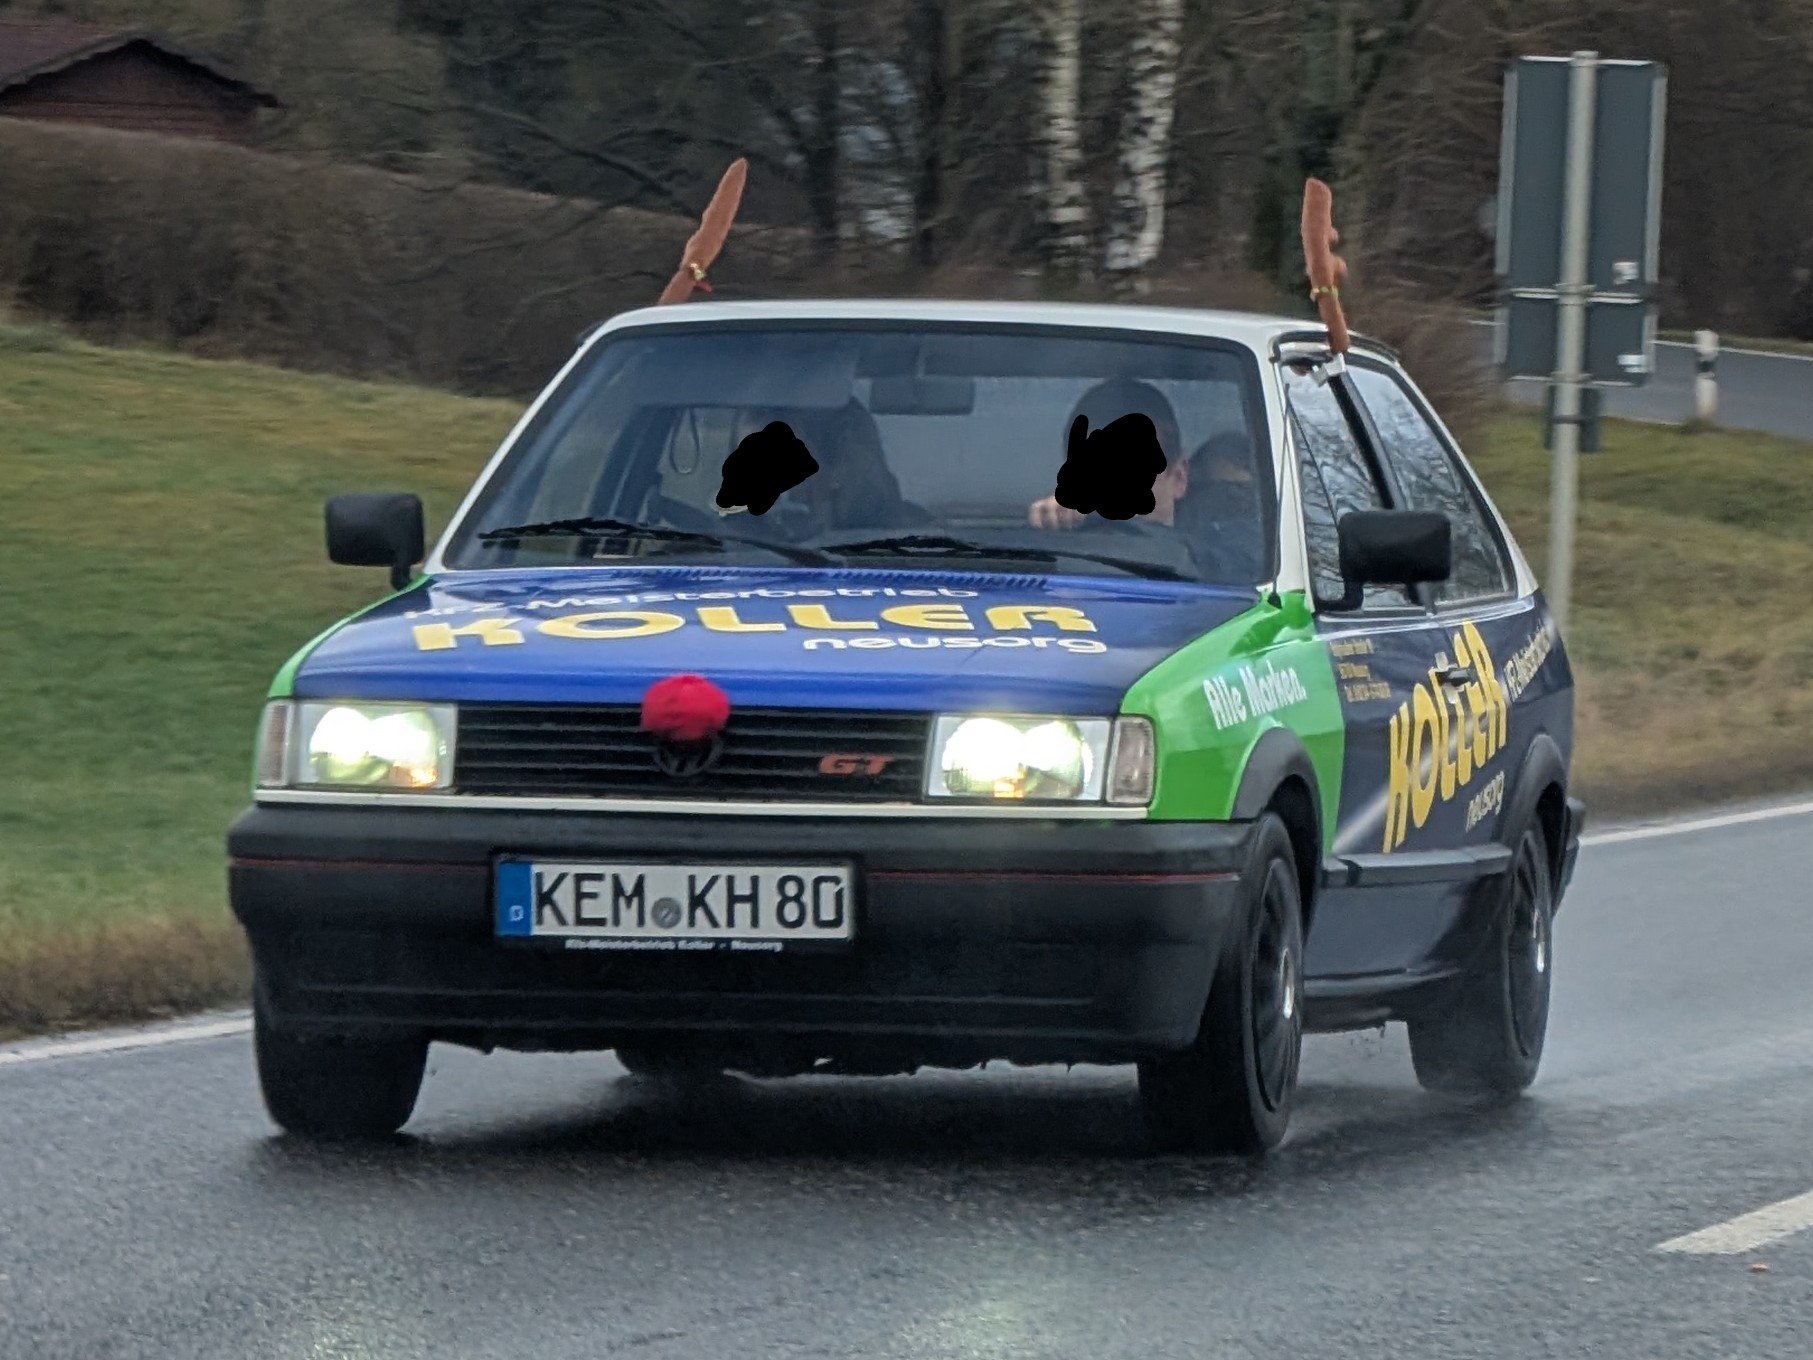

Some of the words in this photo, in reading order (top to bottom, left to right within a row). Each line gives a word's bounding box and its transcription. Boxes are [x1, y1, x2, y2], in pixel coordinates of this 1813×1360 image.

[413, 604, 1097, 650] KOLLER
[803, 636, 1108, 654] neusorg
[1203, 675, 1247, 730] Alle
[1383, 619, 1507, 853] KOLLER
[819, 753, 894, 775] GT
[535, 871, 645, 928] KEM
[687, 873, 760, 929] KH
[776, 874, 845, 930] 80
